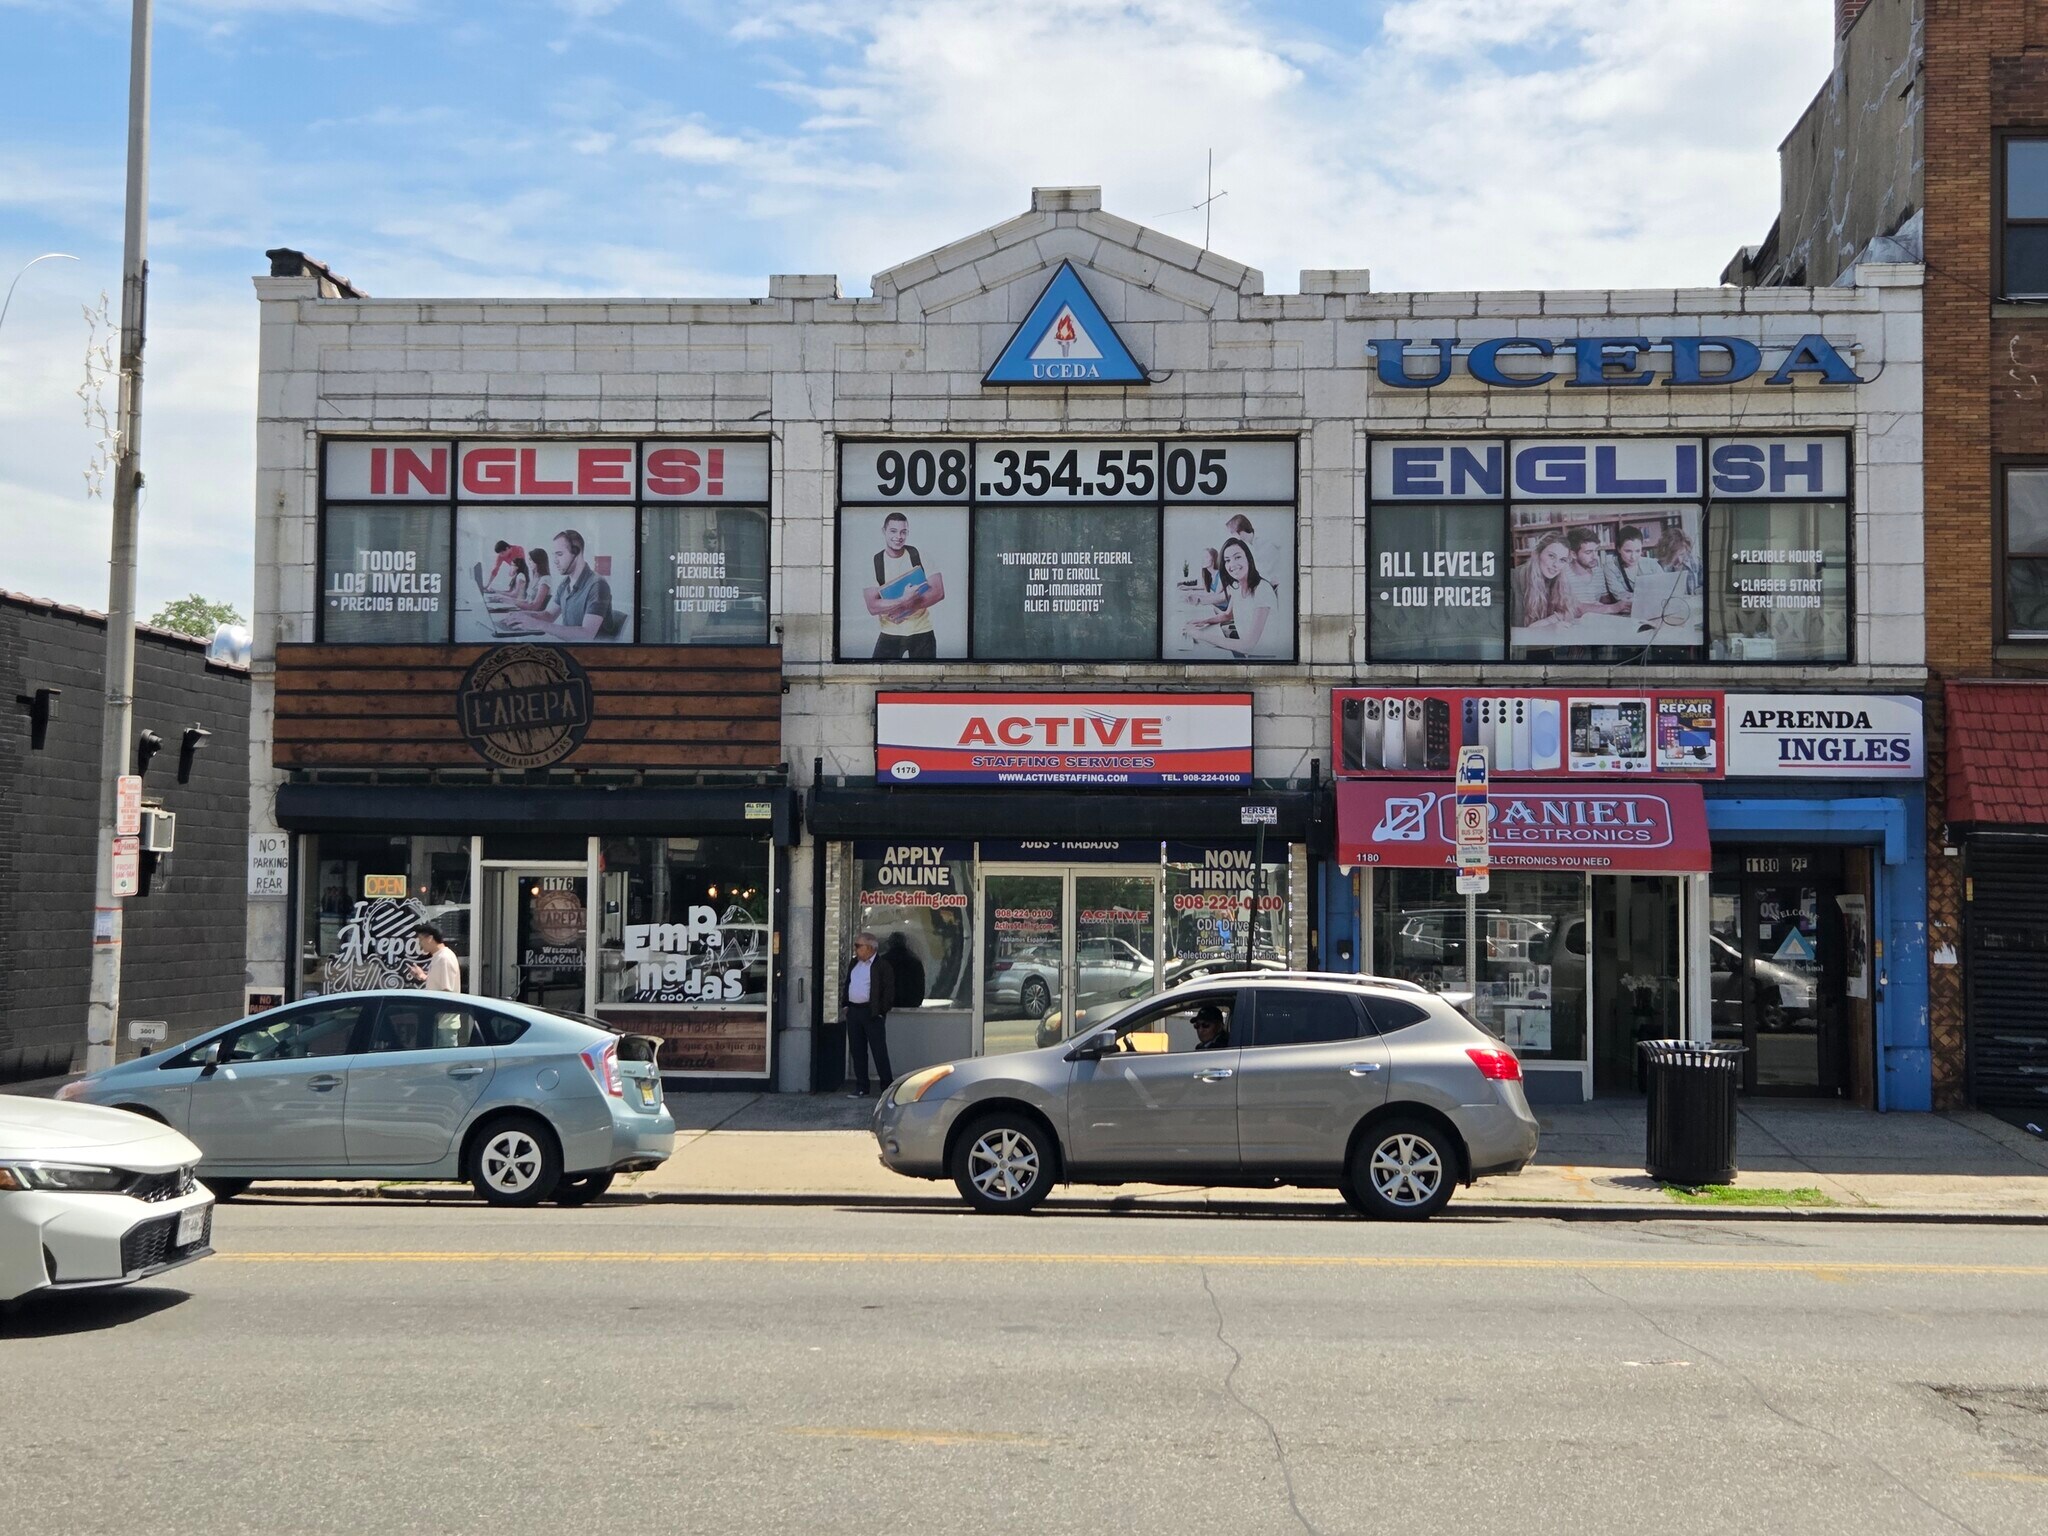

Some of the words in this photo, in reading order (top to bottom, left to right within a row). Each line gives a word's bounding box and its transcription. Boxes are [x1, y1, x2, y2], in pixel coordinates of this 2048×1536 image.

[1367, 334, 1866, 389] UCEDA
[1032, 363, 1101, 379] UCEDA
[370, 447, 725, 496] INGLES!
[876, 448, 1228, 497] 908.354.5505
[1391, 443, 1824, 496] ENGLISH
[360, 550, 417, 571] TODOS
[677, 551, 726, 565] HORARIOS
[1061, 552, 1091, 565] UNDER
[1093, 551, 1134, 565] FEDERAL
[1740, 549, 1786, 563] FLEXIBLE
[1788, 549, 1823, 563] HOURS
[1380, 551, 1416, 578] ALL
[1423, 551, 1495, 577] LEVELS
[677, 566, 726, 579] FLEXIBLES
[1029, 568, 1050, 581] LAW
[1052, 568, 1064, 581] TO
[1066, 568, 1101, 581] ENROLL
[334, 572, 366, 593] LOS
[372, 573, 442, 594] NIVELES
[1026, 583, 1103, 597] NON-IMMIGRANT
[1741, 578, 1787, 592] CLASSES
[1789, 578, 1823, 592] START
[676, 585, 705, 598] INICIO
[708, 586, 740, 599] TODOS
[1393, 586, 1428, 607] LOW
[1433, 586, 1492, 607] PRICES
[340, 596, 394, 612] PRECIOS
[397, 597, 439, 612] BAJOS
[675, 600, 695, 612] LOS
[697, 600, 727, 613] LUNES
[1024, 599, 1050, 612] ALIEN
[1741, 594, 1774, 609] EVERY
[1776, 594, 1821, 608] MONDAY
[473, 688, 577, 728] L'AREPA
[1659, 704, 1713, 714] REPAIR
[1740, 710, 1873, 729] APRENDA
[956, 716, 1164, 748] ACTIVE
[486, 744, 543, 767] EMPANADAS
[1778, 737, 1911, 762] INGLES
[972, 756, 1060, 768] STAFFING
[1065, 757, 1156, 769] SERVICES
[895, 766, 917, 775] 1178
[998, 773, 1128, 783] WWW.ACTIVESTAFFING.COM
[1161, 774, 1181, 783] TEL.
[1183, 774, 1241, 783] 908-224-0100
[1241, 807, 1276, 815] JERSEY
[259, 838, 277, 853] NO
[253, 857, 288, 869] PARKING
[884, 846, 945, 866] APPLY
[1205, 850, 1252, 869] NOW
[1356, 853, 1380, 863] 1180
[1559, 857, 1581, 866] YOU
[1583, 857, 1611, 866] NEED
[1747, 859, 1778, 872] 1180
[256, 877, 283, 889] REAR
[878, 866, 949, 886] ONLINE
[367, 877, 404, 895] OPEN
[544, 878, 574, 890] 1176
[860, 889, 968, 910] ActiveStaffing.com
[1080, 909, 1149, 920] ACTIVE
[1196, 919, 1219, 931] CDL
[1222, 919, 1260, 931] Drives
[1196, 937, 1225, 946] Forklift
[525, 948, 587, 966] Bienvenid
[1178, 950, 1214, 960] Selectors
[260, 995, 272, 1004] NO
